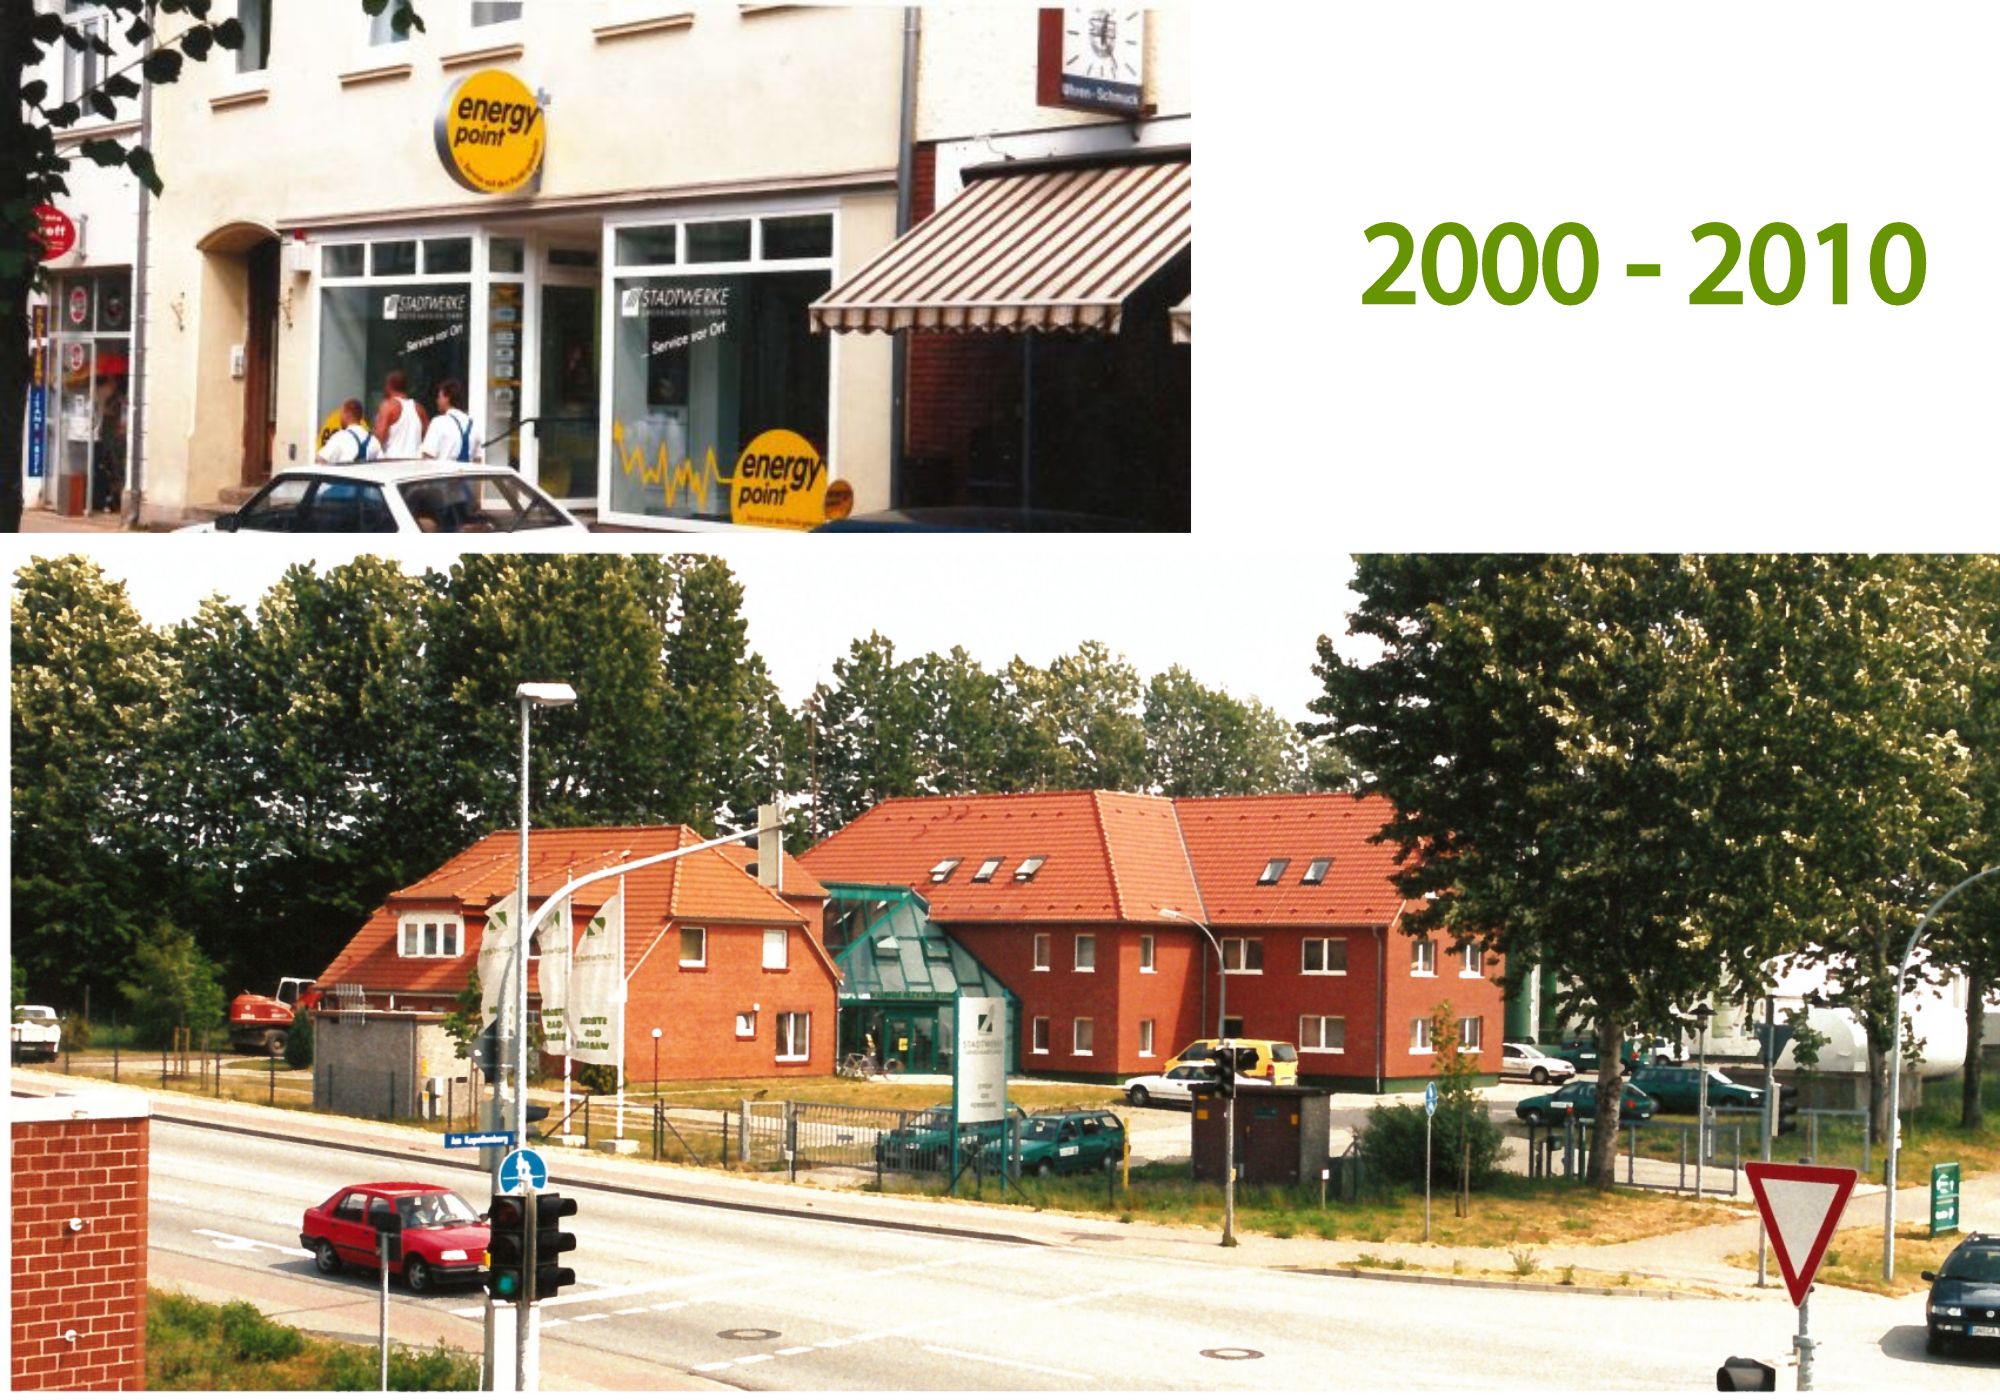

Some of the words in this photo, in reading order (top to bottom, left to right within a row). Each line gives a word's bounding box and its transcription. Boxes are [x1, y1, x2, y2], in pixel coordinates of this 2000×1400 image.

[458, 96, 544, 136] energy
[454, 124, 505, 148] point
[400, 294, 466, 312] STADTWERKE
[643, 288, 729, 307] STADTWERKE
[709, 320, 726, 337] Ort
[742, 453, 824, 492] energy
[738, 481, 787, 509] point
